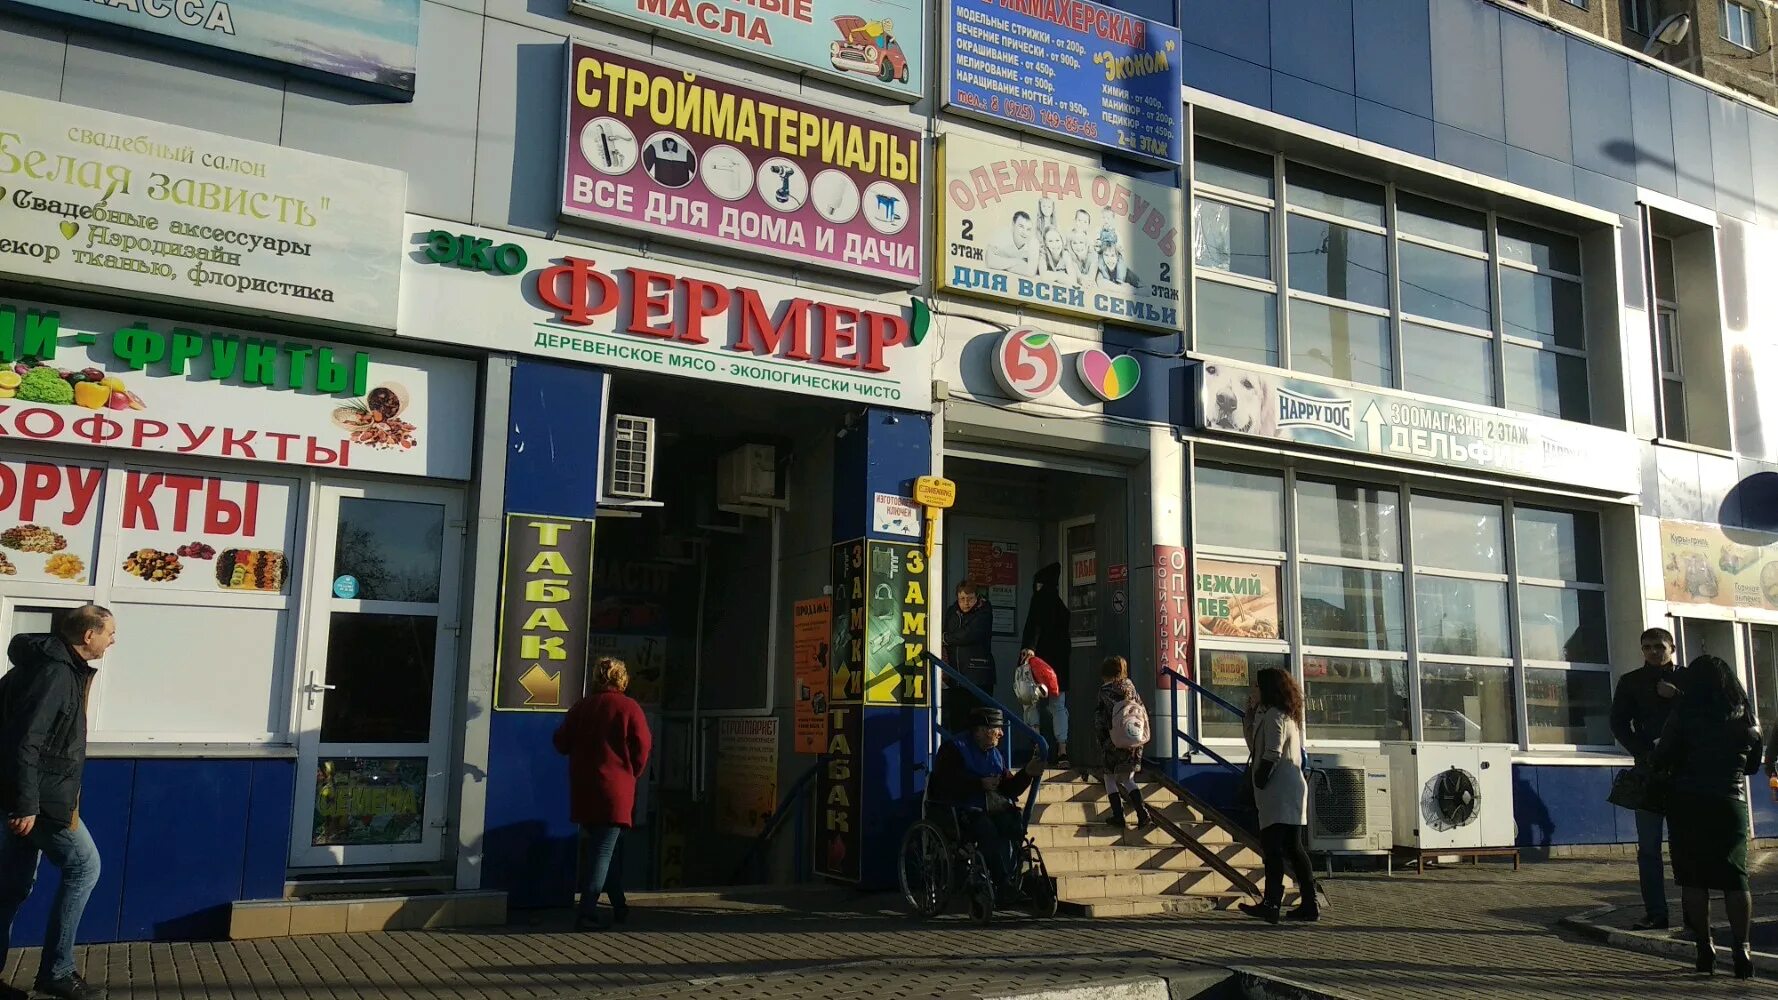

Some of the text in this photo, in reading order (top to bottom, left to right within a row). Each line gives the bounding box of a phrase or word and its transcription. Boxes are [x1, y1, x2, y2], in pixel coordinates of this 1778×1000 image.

[956, 5, 1010, 32] МОДЕЛЬНЫЕ
[1011, 22, 1051, 44] СТРИЖКИ
[956, 22, 1000, 45] ВЕЧЕРНИЕ
[1001, 35, 1045, 58] ПРИЧЕСКИ
[956, 38, 1019, 66] ОКРАШИВАНИЕ
[956, 54, 1019, 82] МЕЛИРОВАНИЕ
[956, 70, 1020, 97] НАРАЩИВАНИЕ
[1021, 88, 1054, 106] НОГТЕЙ
[990, 94, 1000, 112] 8
[1003, 97, 1036, 122] (925)
[1101, 84, 1129, 100] ХИМИЯ
[1101, 98, 1140, 116] МАНИКЮР
[576, 57, 918, 184] СТРОЙМАТЕРИАЛЫ
[1101, 111, 1140, 129] ПЕДИКЮР
[0, 131, 132, 202] Белая
[67, 126, 267, 179] свадебный салон
[13, 189, 312, 260] Свадебные аксессуары
[572, 174, 915, 271] ВСЕ ДЛЯ ДОМА И ДАЧИ
[949, 159, 1178, 258] ОДЕЖДА ОБУВЬ
[961, 219, 974, 241] 2
[86, 223, 242, 267] Аэродизайн
[425, 229, 528, 276] ЭКО
[950, 242, 984, 261] этаж
[187, 260, 335, 304] флористика
[1159, 262, 1171, 283] 2
[536, 255, 911, 373] ФЕРМЕР
[952, 265, 1177, 326] ДЛЯ ВСЕЙ СЕМЬИ
[112, 321, 370, 396] ФРУКТЫ
[534, 331, 664, 365] ДЕРЕВЕНСКОЕ
[668, 354, 716, 372] МЯСО
[729, 363, 850, 394] ЭКОЛОГИЧЕСКИ
[853, 383, 901, 401] ЧИСТО
[1279, 395, 1351, 431] HAPPY DOG
[1390, 403, 1529, 446] ЗООМАГАЗИН 2 ЭТАЖ
[0, 405, 351, 467] ОФРУКТЫ
[521, 522, 573, 660] ТАБАК
[849, 545, 863, 694] ЗАМКИ
[902, 550, 926, 698] ЗАМКИ
[826, 708, 851, 833] ТАБАК
